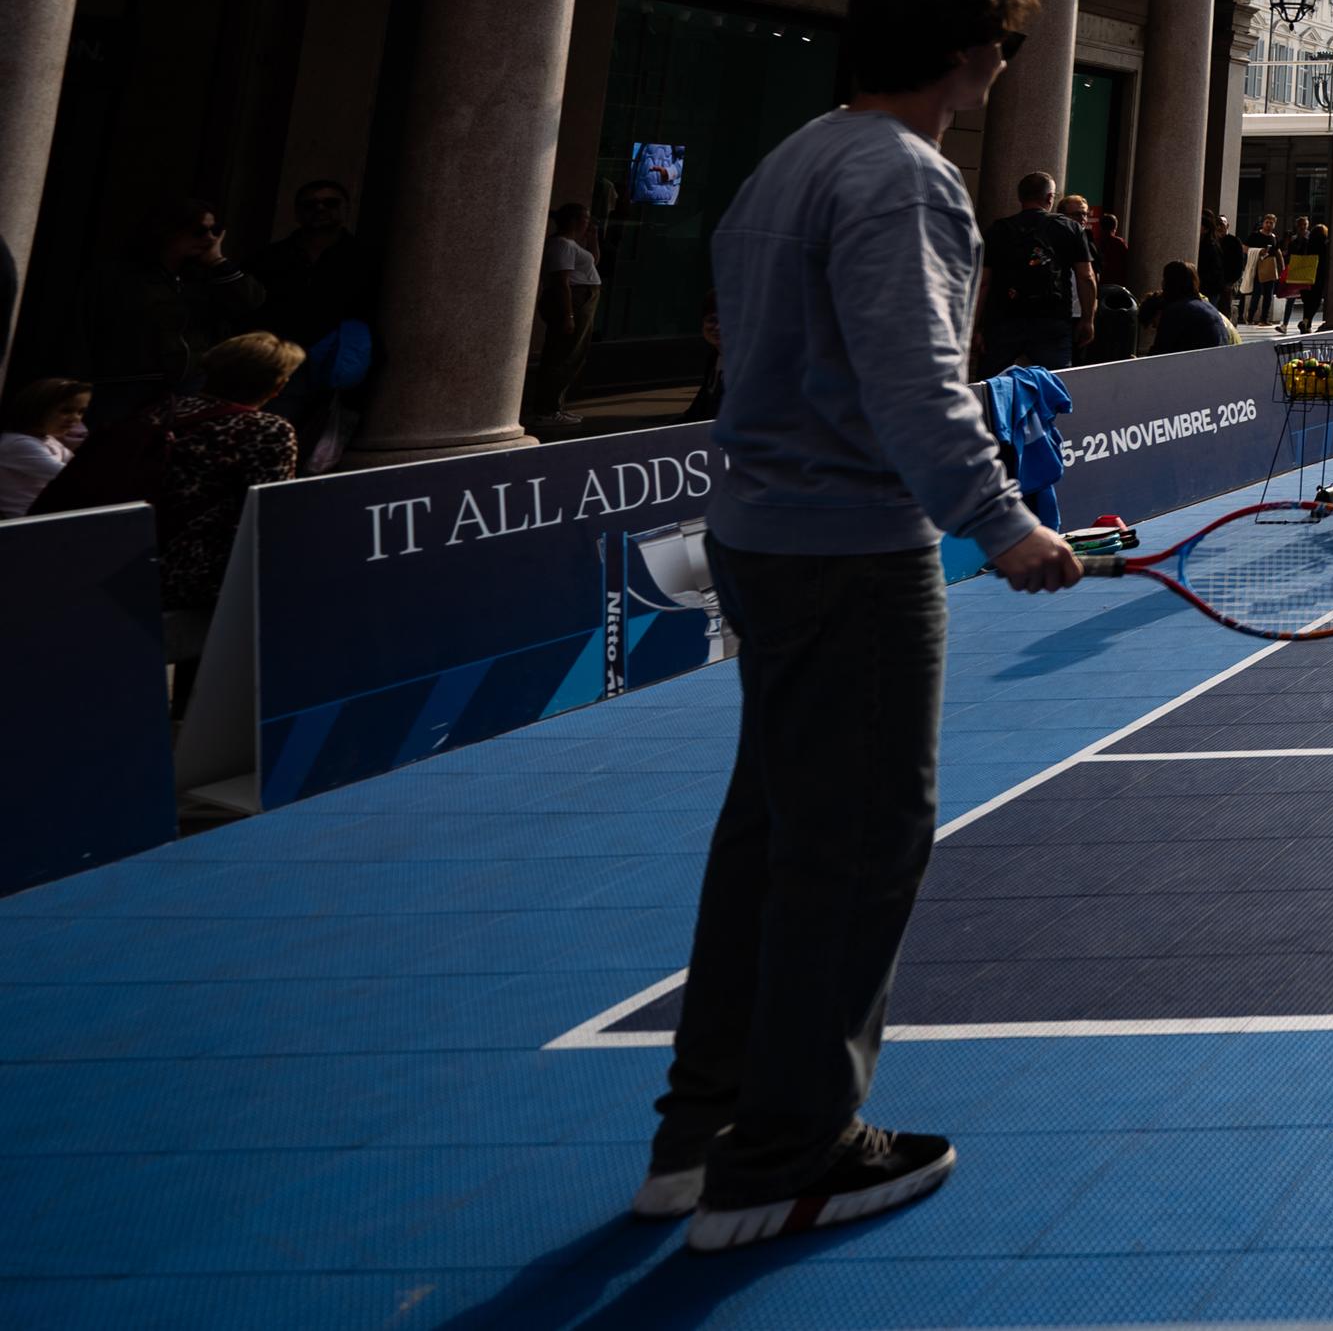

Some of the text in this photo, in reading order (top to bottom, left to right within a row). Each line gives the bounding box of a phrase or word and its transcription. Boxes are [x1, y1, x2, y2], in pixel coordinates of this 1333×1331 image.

[1060, 398, 1258, 468] 5-22 NOVEMBRE, 2026
[365, 449, 713, 563] IT ALL ADDS
[606, 590, 622, 663] Nitto
